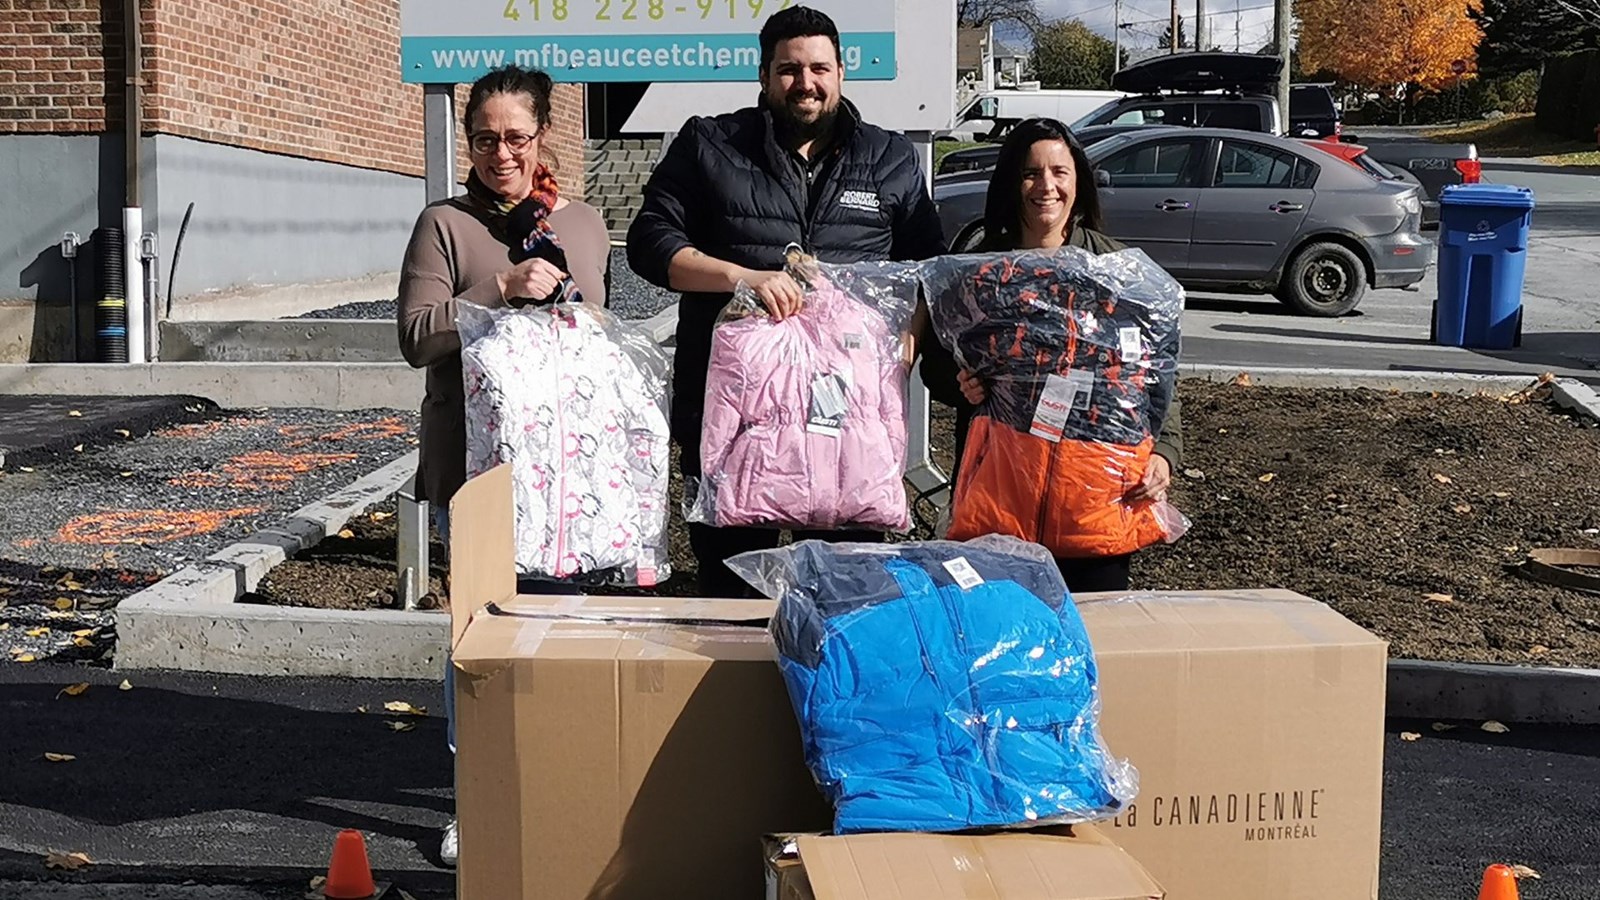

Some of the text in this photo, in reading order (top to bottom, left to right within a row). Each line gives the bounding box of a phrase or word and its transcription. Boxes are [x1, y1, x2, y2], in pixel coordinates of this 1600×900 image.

[503, 0, 790, 21] 418 228-919
[1152, 789, 1319, 826] CANADIENNE
[1244, 823, 1317, 841] MONTRÉAL
